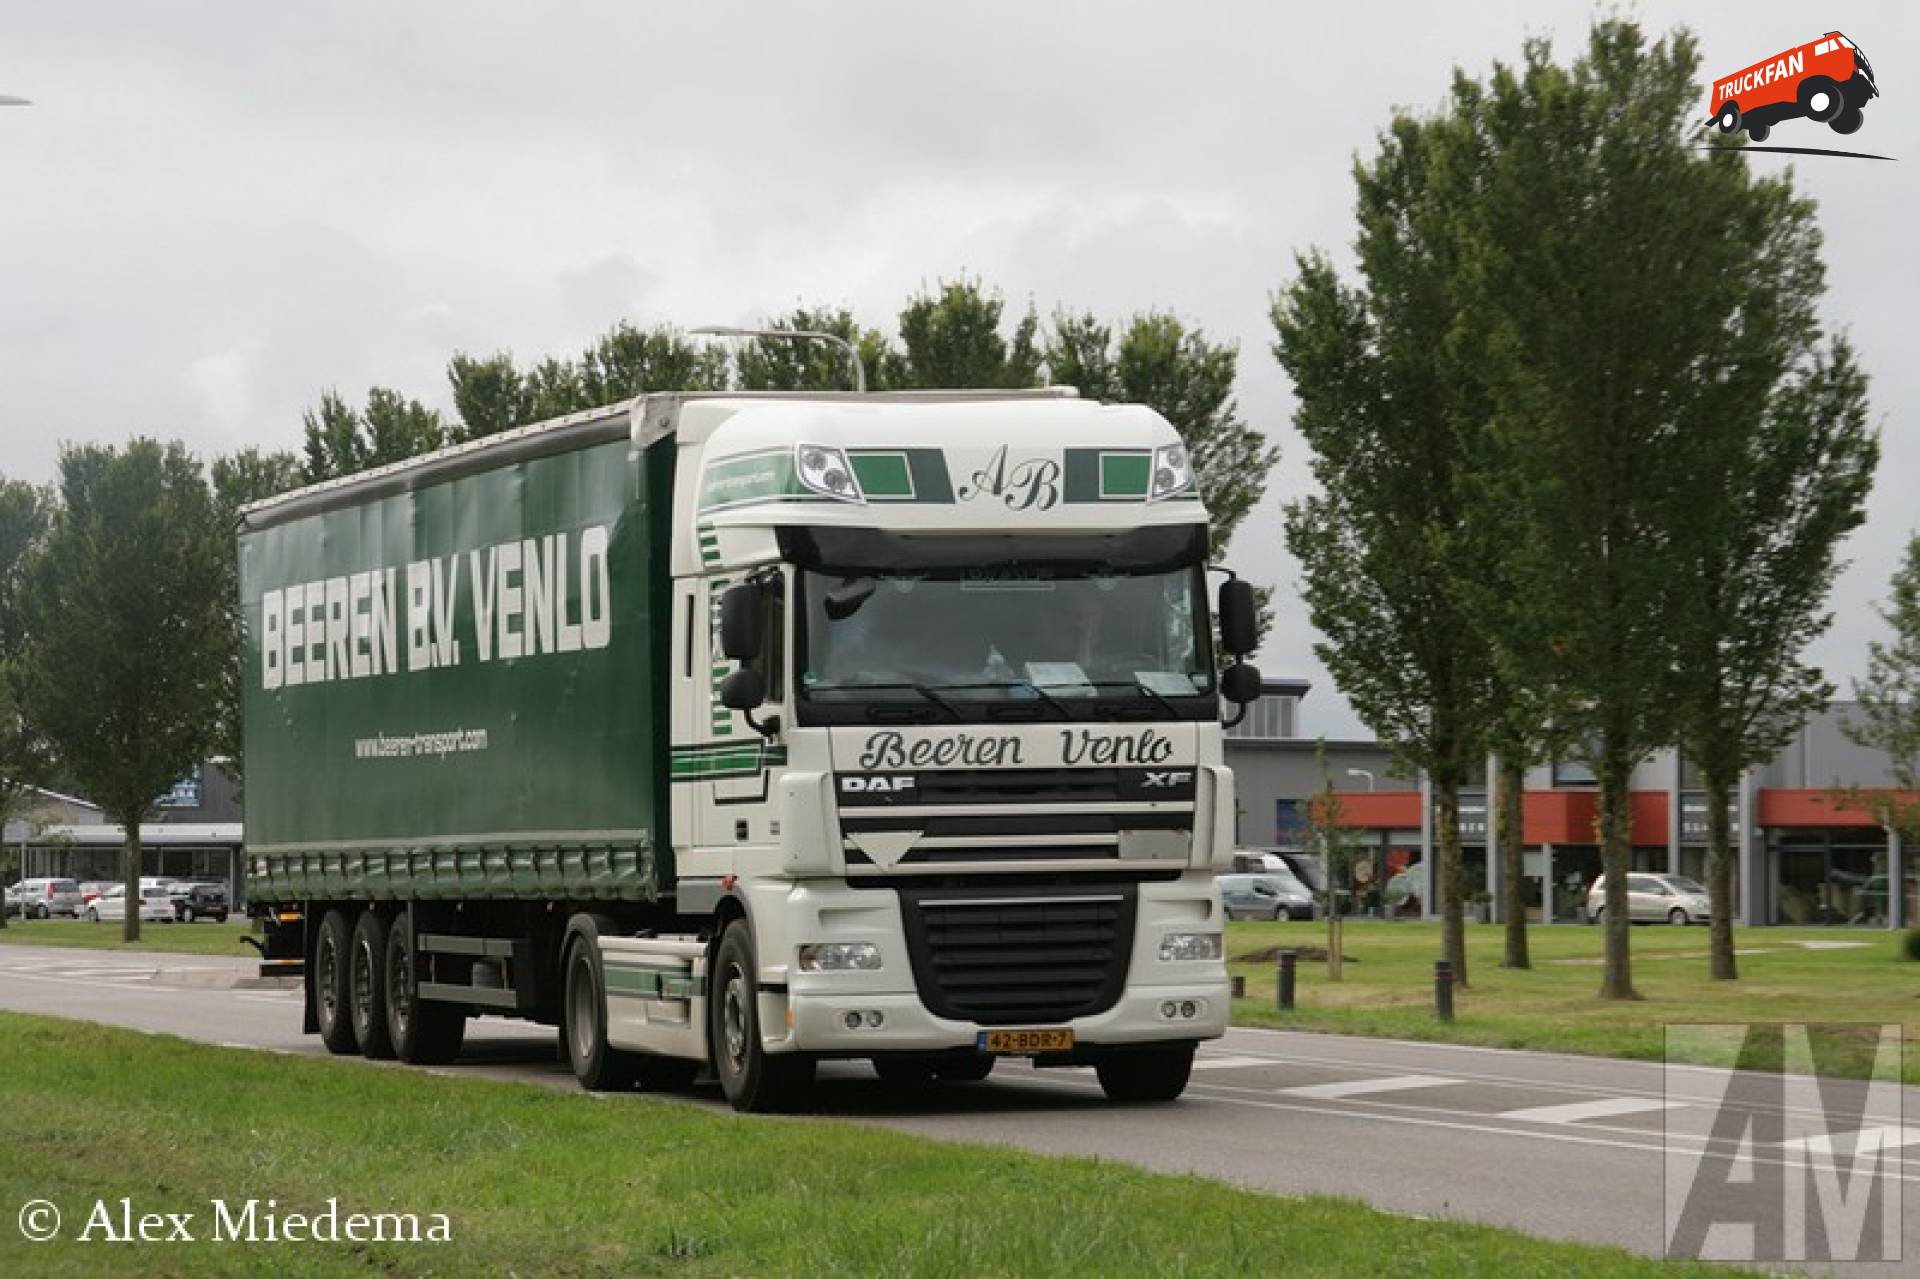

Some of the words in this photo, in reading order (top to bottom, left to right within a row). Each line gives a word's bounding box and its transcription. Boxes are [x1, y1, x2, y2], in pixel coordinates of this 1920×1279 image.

[262, 567, 398, 689] BEEREN
[407, 553, 460, 672] B.V.
[469, 525, 611, 662] VENLO
[858, 730, 1024, 769] Beeren
[1060, 729, 1174, 765] Venlo
[841, 776, 916, 793] DAF
[1139, 772, 1192, 788] XF
